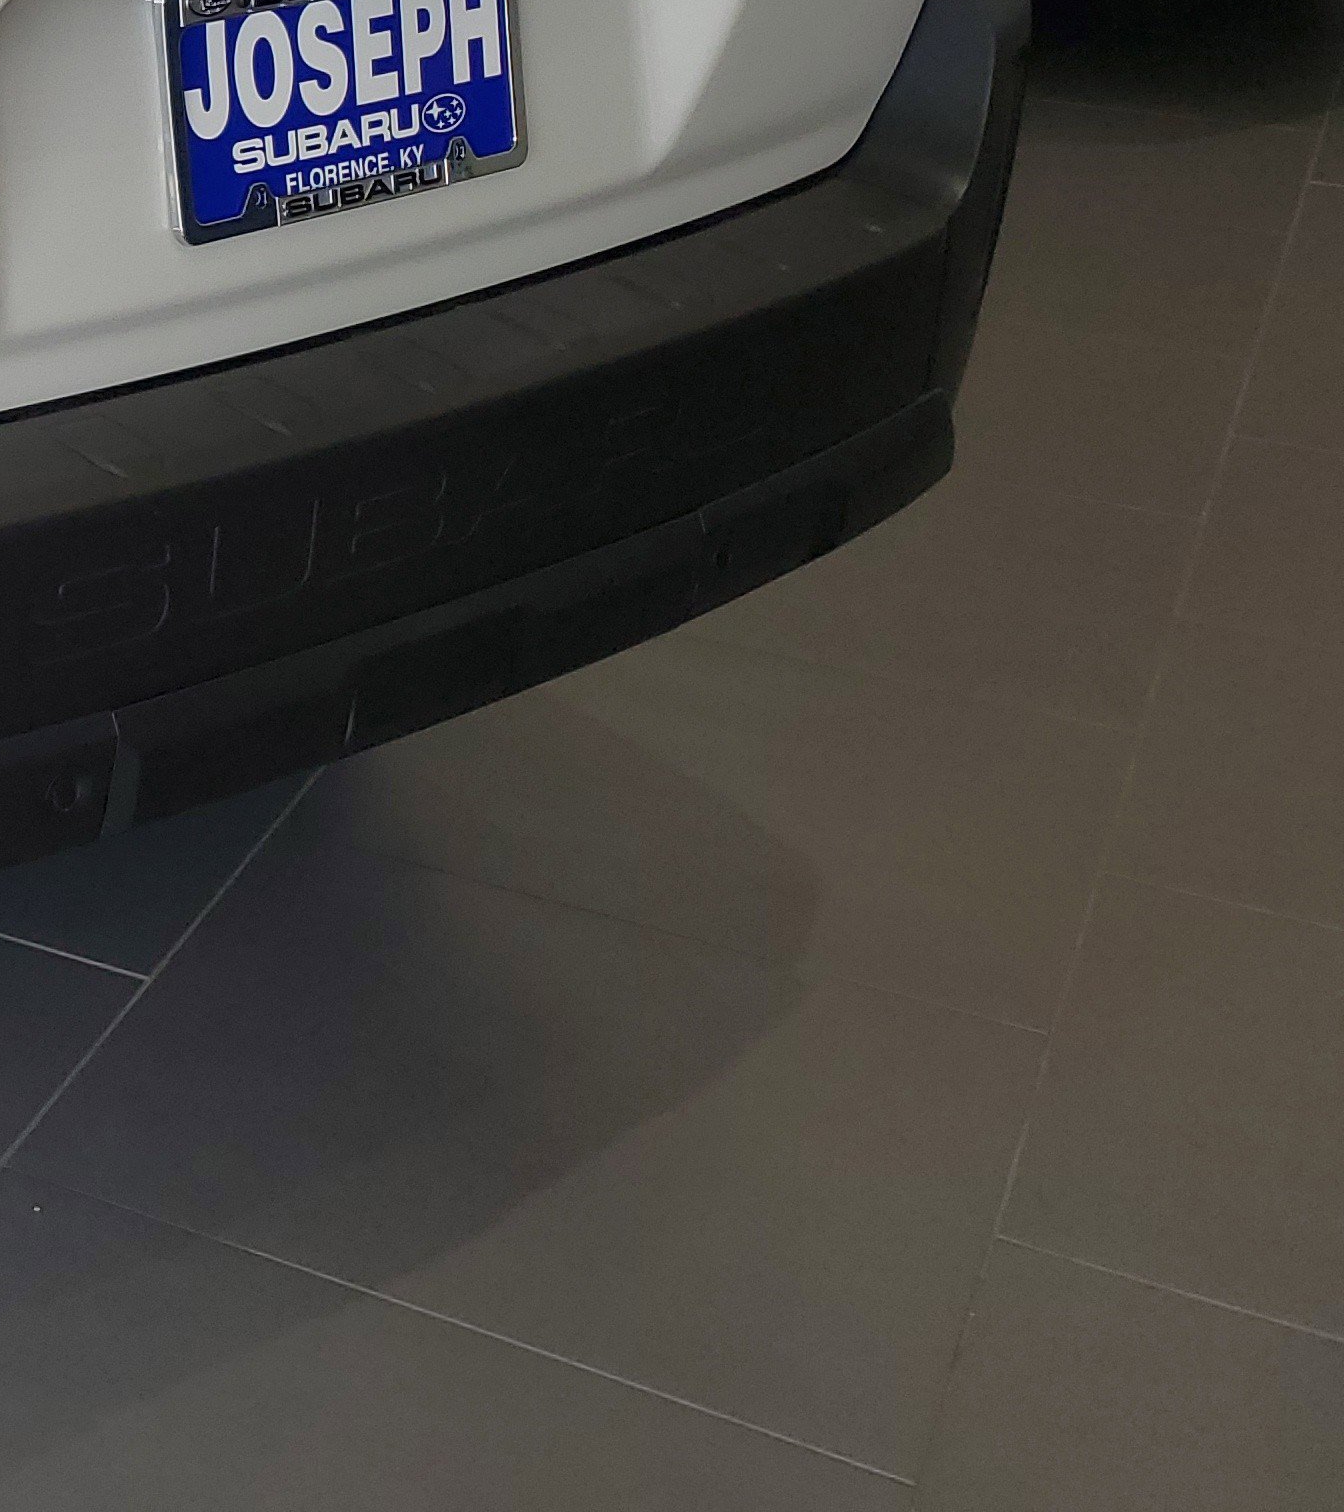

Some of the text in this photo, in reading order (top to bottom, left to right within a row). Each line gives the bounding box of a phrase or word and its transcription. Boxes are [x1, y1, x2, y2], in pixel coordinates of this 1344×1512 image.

[232, 103, 421, 174] SUBARU
[399, 143, 425, 169] KY
[282, 165, 443, 219] SUBARU
